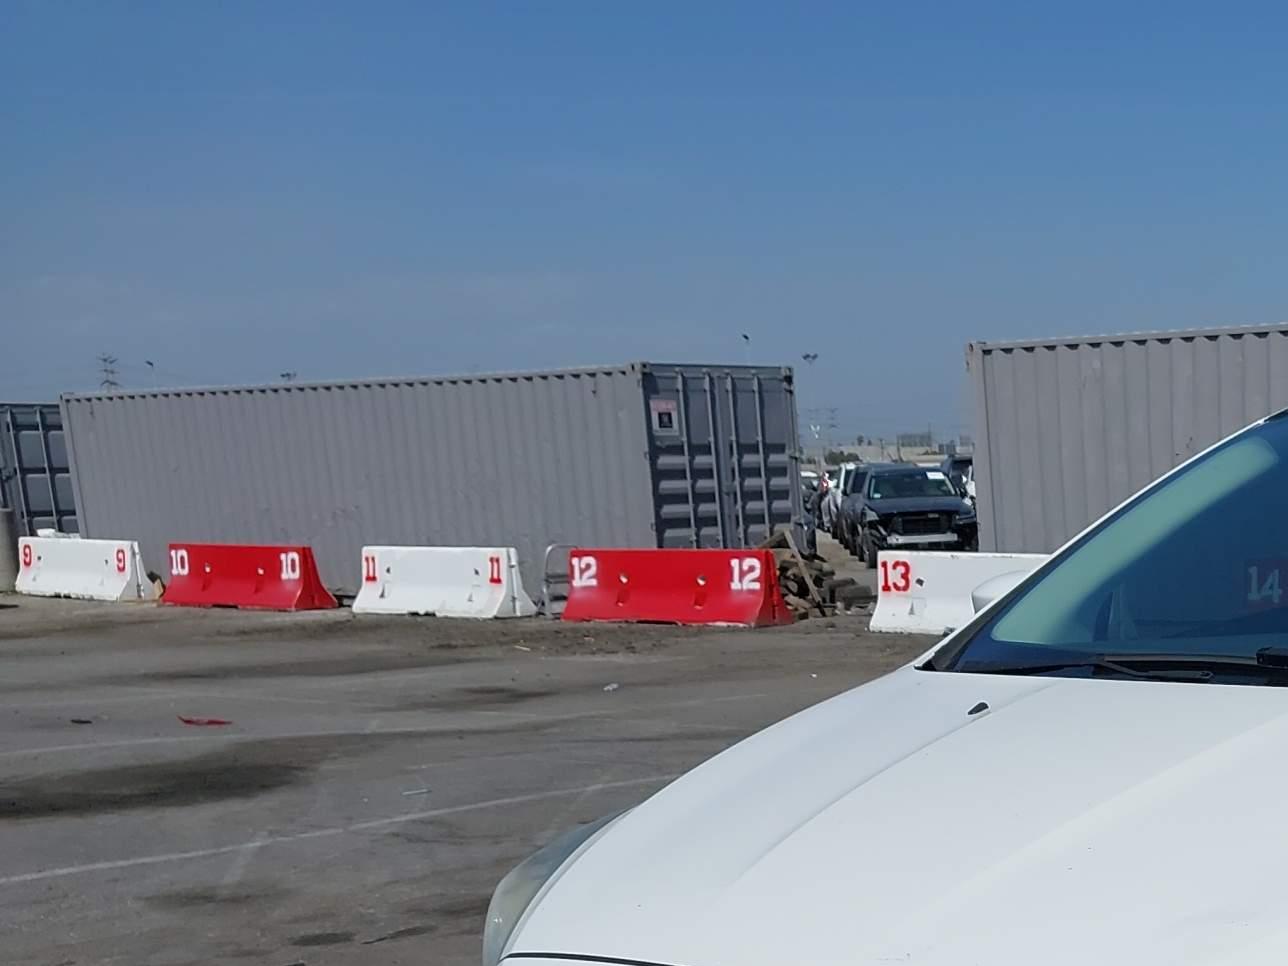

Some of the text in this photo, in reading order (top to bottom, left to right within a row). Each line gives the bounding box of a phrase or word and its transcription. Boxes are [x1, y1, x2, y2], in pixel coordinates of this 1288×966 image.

[22, 544, 32, 567] 9
[115, 548, 127, 573] 9
[170, 549, 189, 577] 10
[279, 551, 301, 581] 10
[364, 555, 378, 582] 11
[488, 555, 503, 585] 11
[570, 555, 598, 588] 12
[729, 557, 760, 590] 12
[880, 560, 911, 592] 13
[1247, 565, 1283, 603] 14
